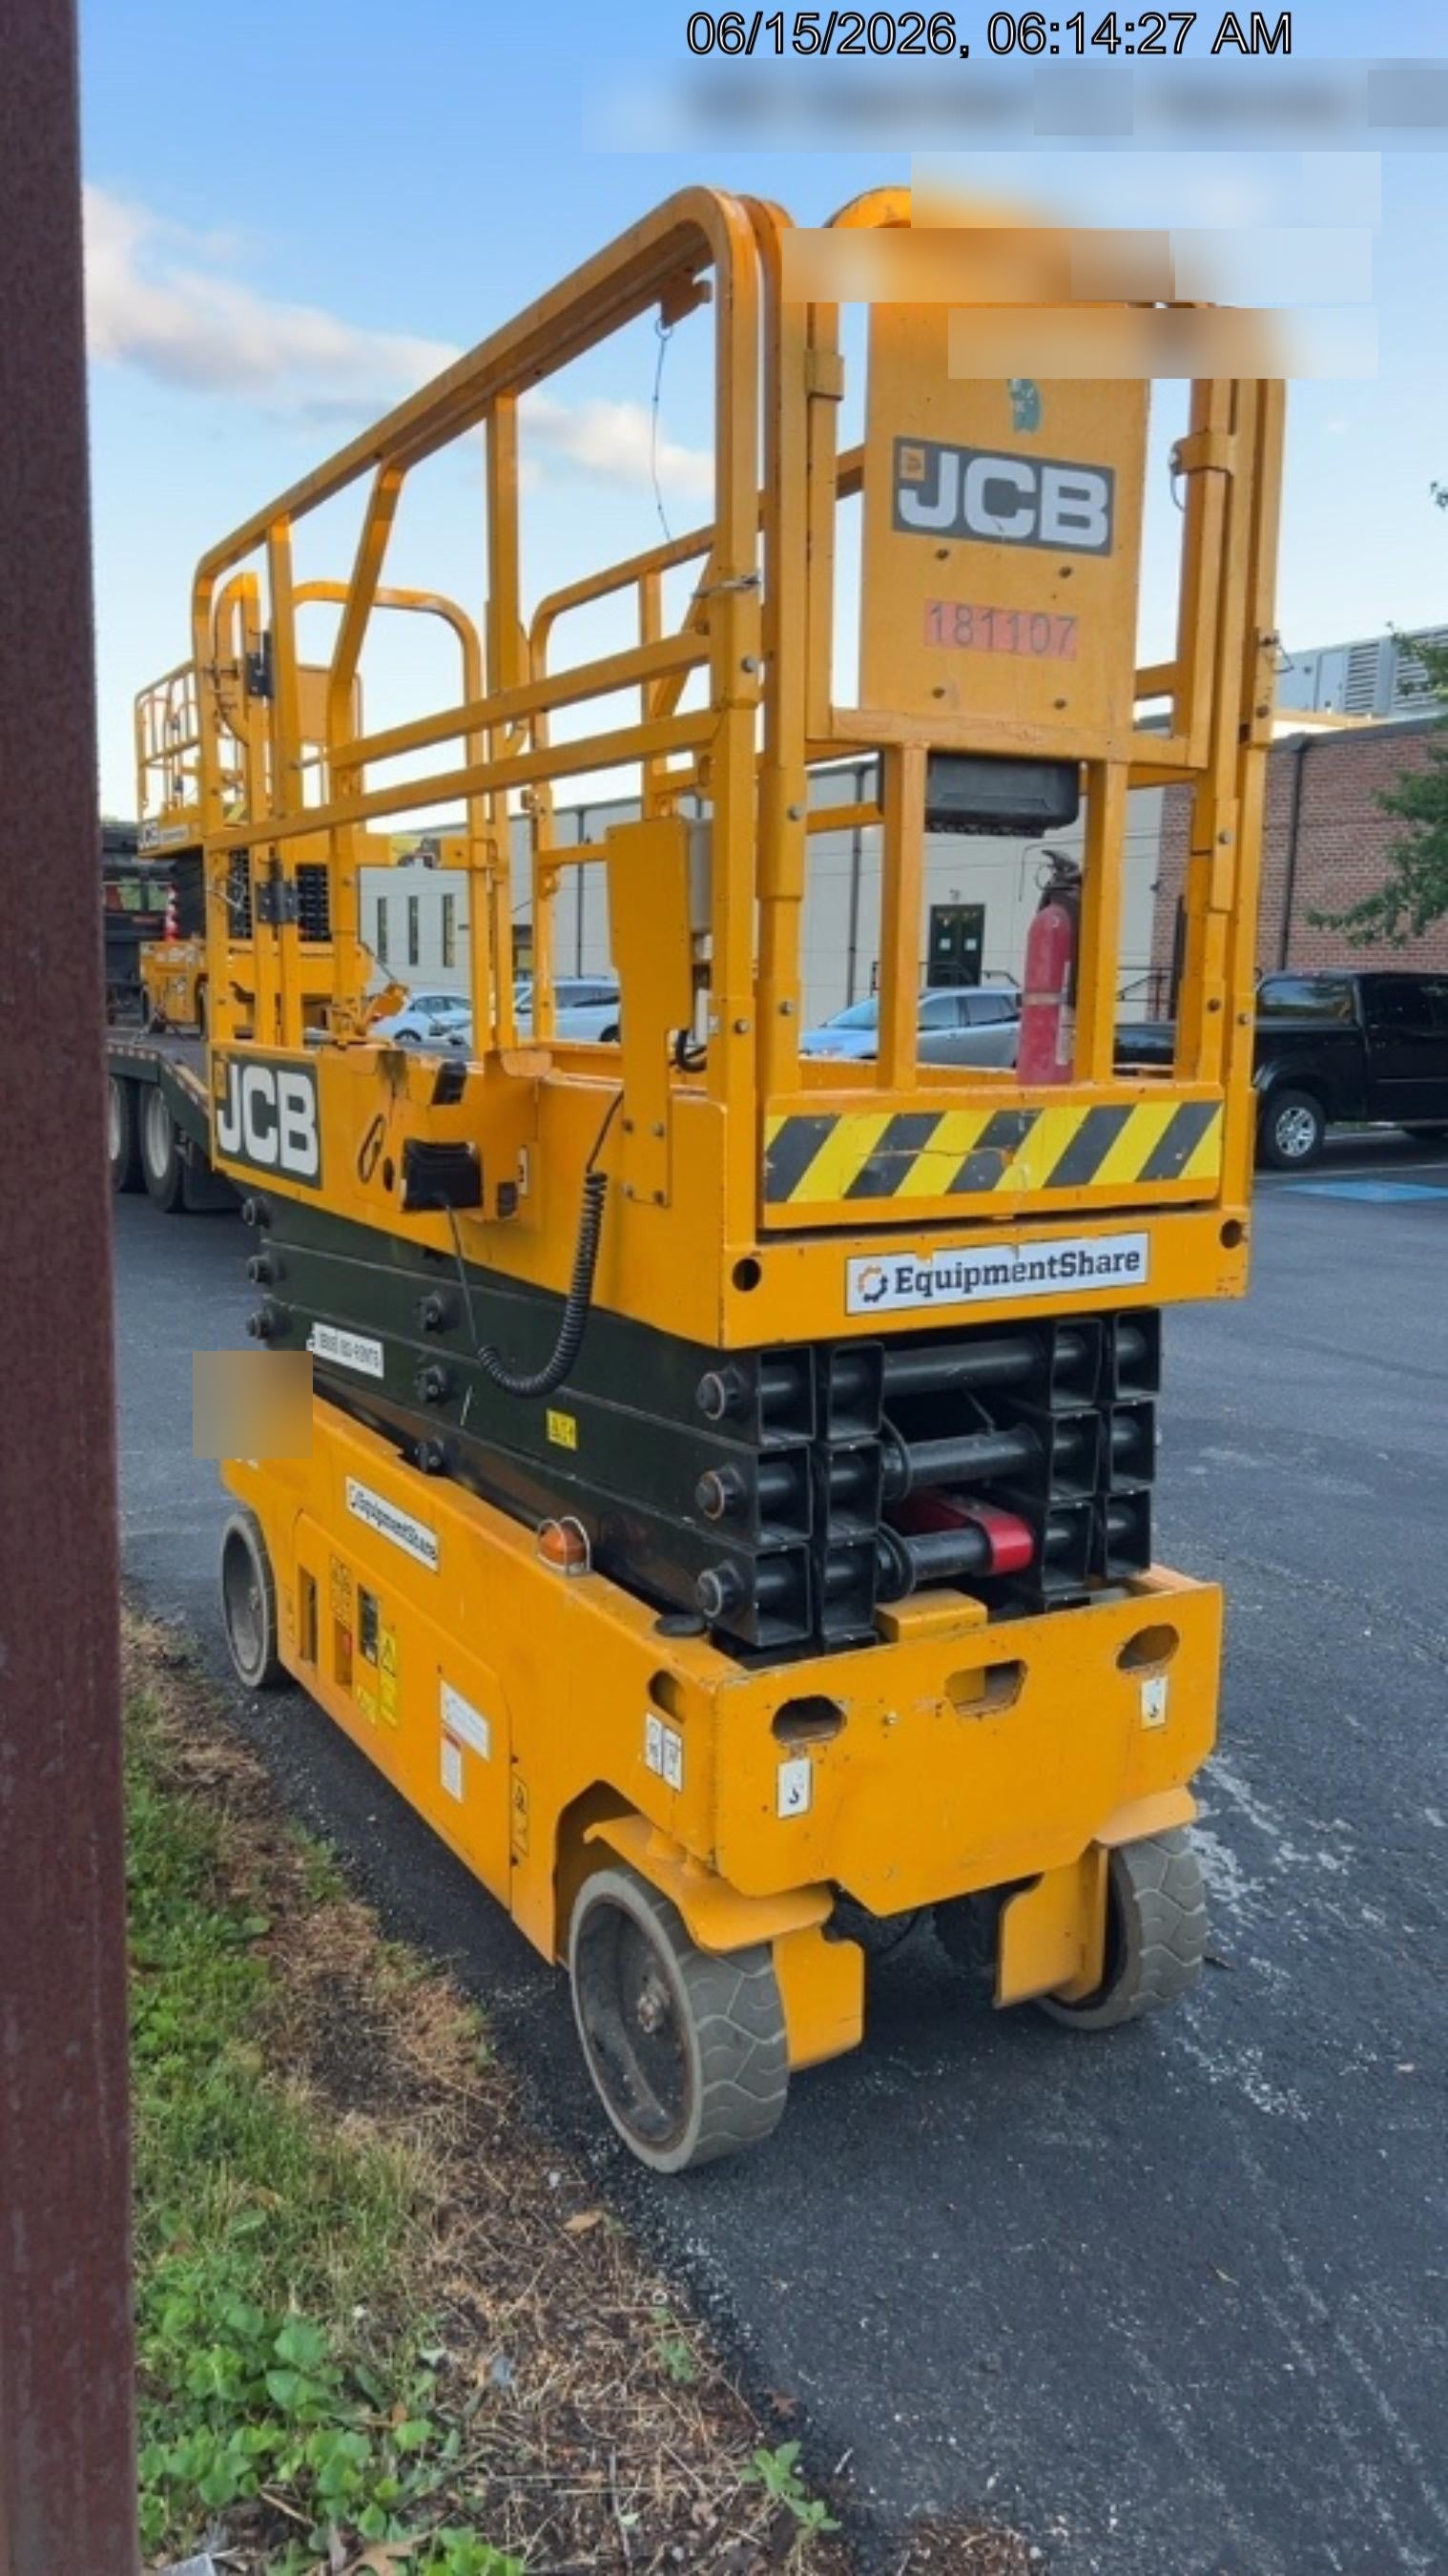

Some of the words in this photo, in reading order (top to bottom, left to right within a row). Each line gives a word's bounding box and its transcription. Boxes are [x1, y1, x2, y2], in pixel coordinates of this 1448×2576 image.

[899, 451, 1108, 547] JCB
[929, 602, 1078, 656] 181107
[217, 1064, 319, 1175] JCB
[894, 1250, 1141, 1298] EquipmentShare
